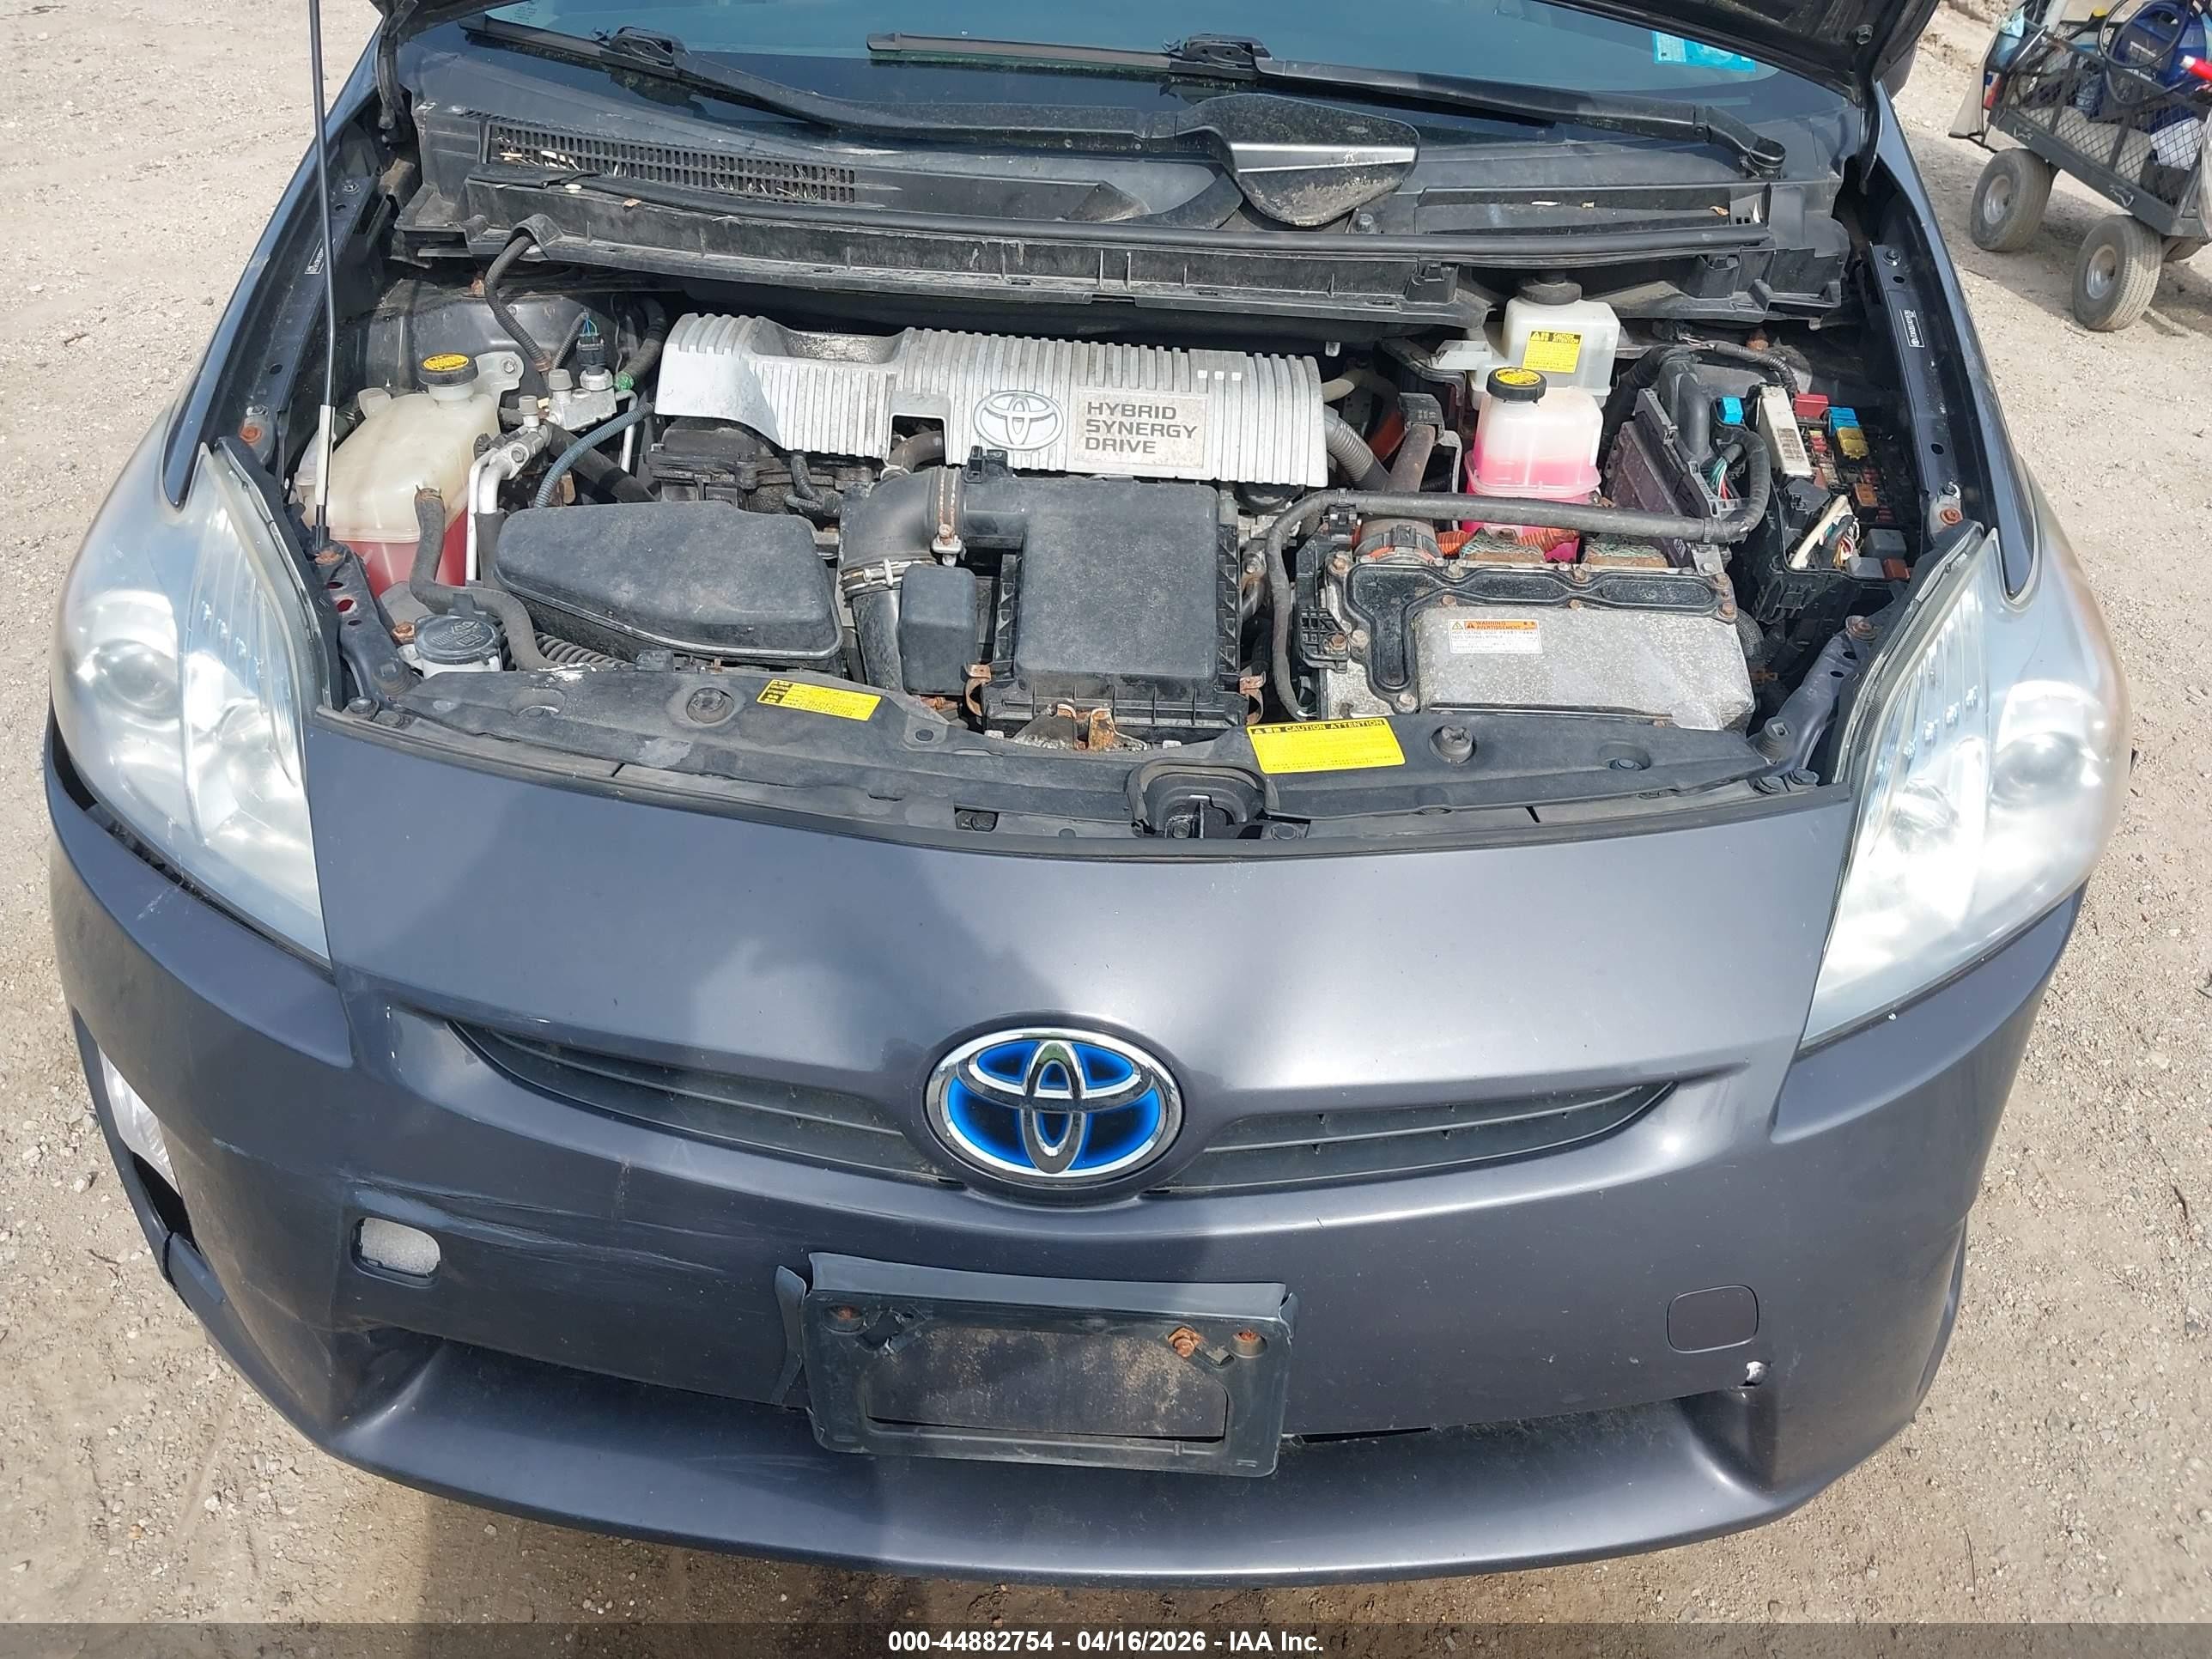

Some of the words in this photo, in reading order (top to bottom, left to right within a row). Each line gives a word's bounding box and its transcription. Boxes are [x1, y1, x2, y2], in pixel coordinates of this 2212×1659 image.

[1087, 401, 1176, 420] HYBRID
[1085, 419, 1198, 440] SYNERGY
[1085, 437, 1157, 454] DRIVE
[1285, 723, 1327, 732] CAUTION
[1330, 720, 1383, 730] ATTENTION
